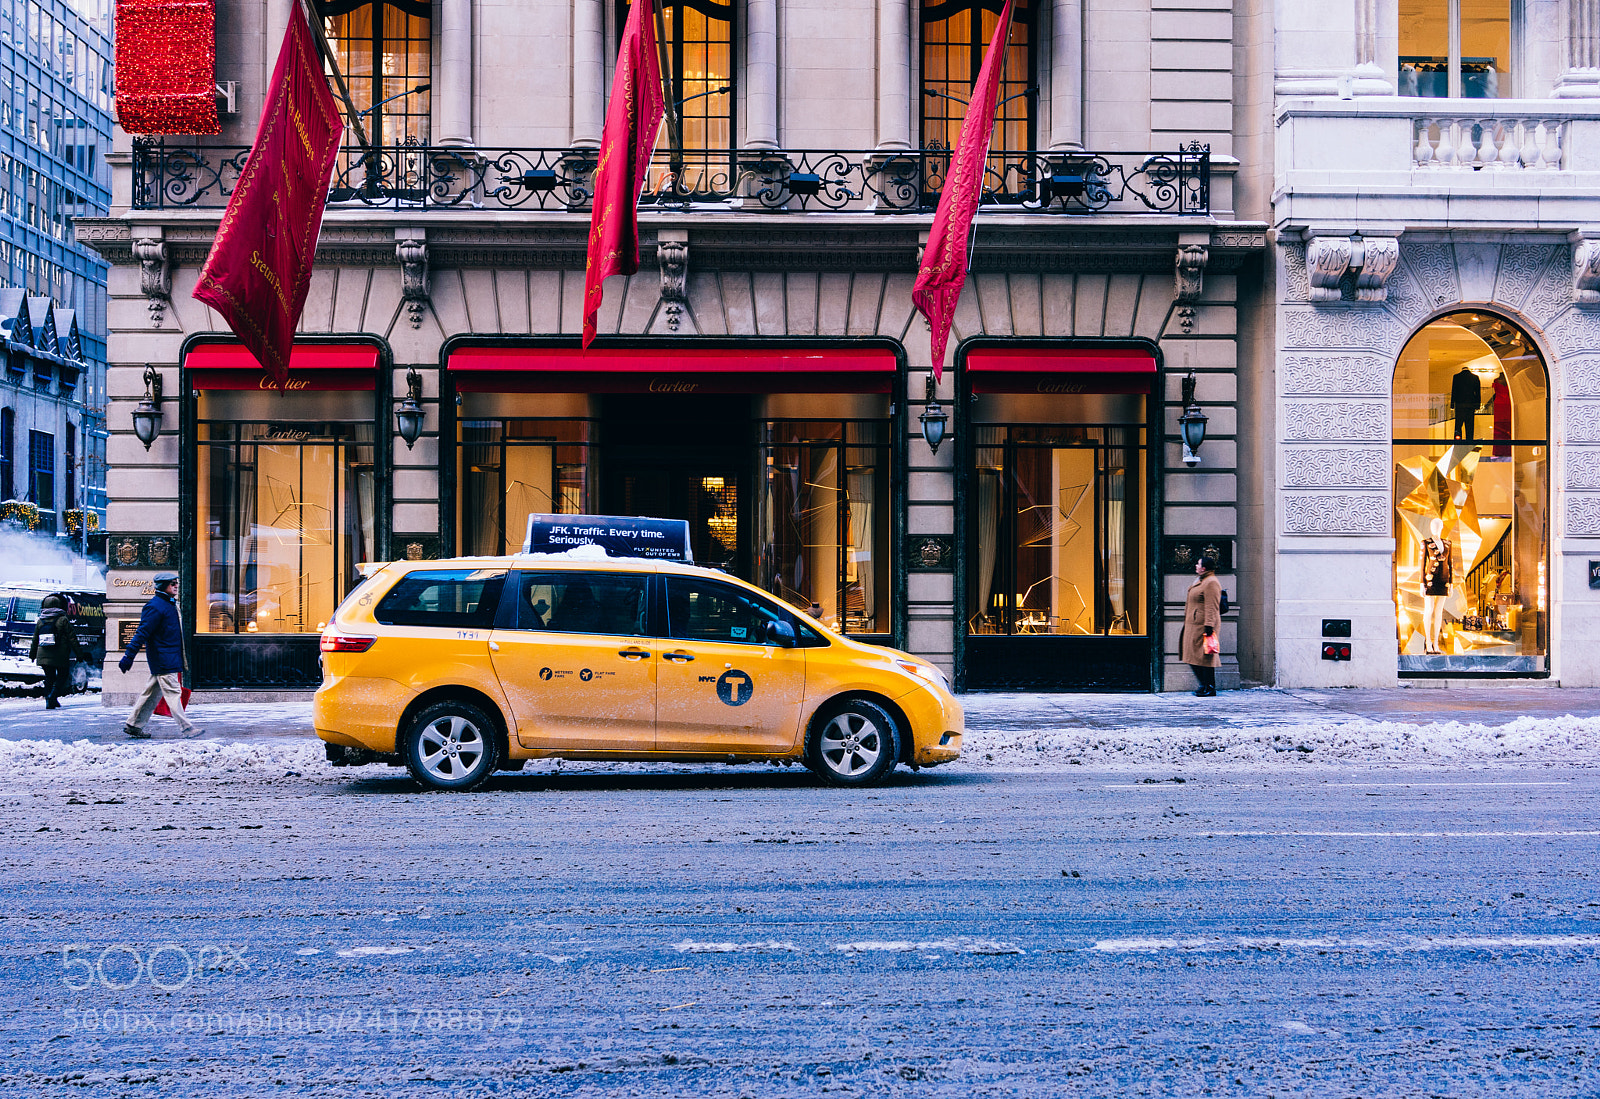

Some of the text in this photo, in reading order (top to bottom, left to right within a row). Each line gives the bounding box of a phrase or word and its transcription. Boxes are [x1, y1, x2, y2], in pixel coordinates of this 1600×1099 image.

[259, 374, 310, 390] Catier
[648, 377, 699, 392] Cartier
[1036, 377, 1088, 393] Cartier
[264, 426, 310, 440] Cartier
[549, 526, 665, 539] JFK. Traffic. Every time.
[549, 535, 596, 545] Seriously.
[77, 602, 106, 618] Contract
[725, 676, 746, 702] T
